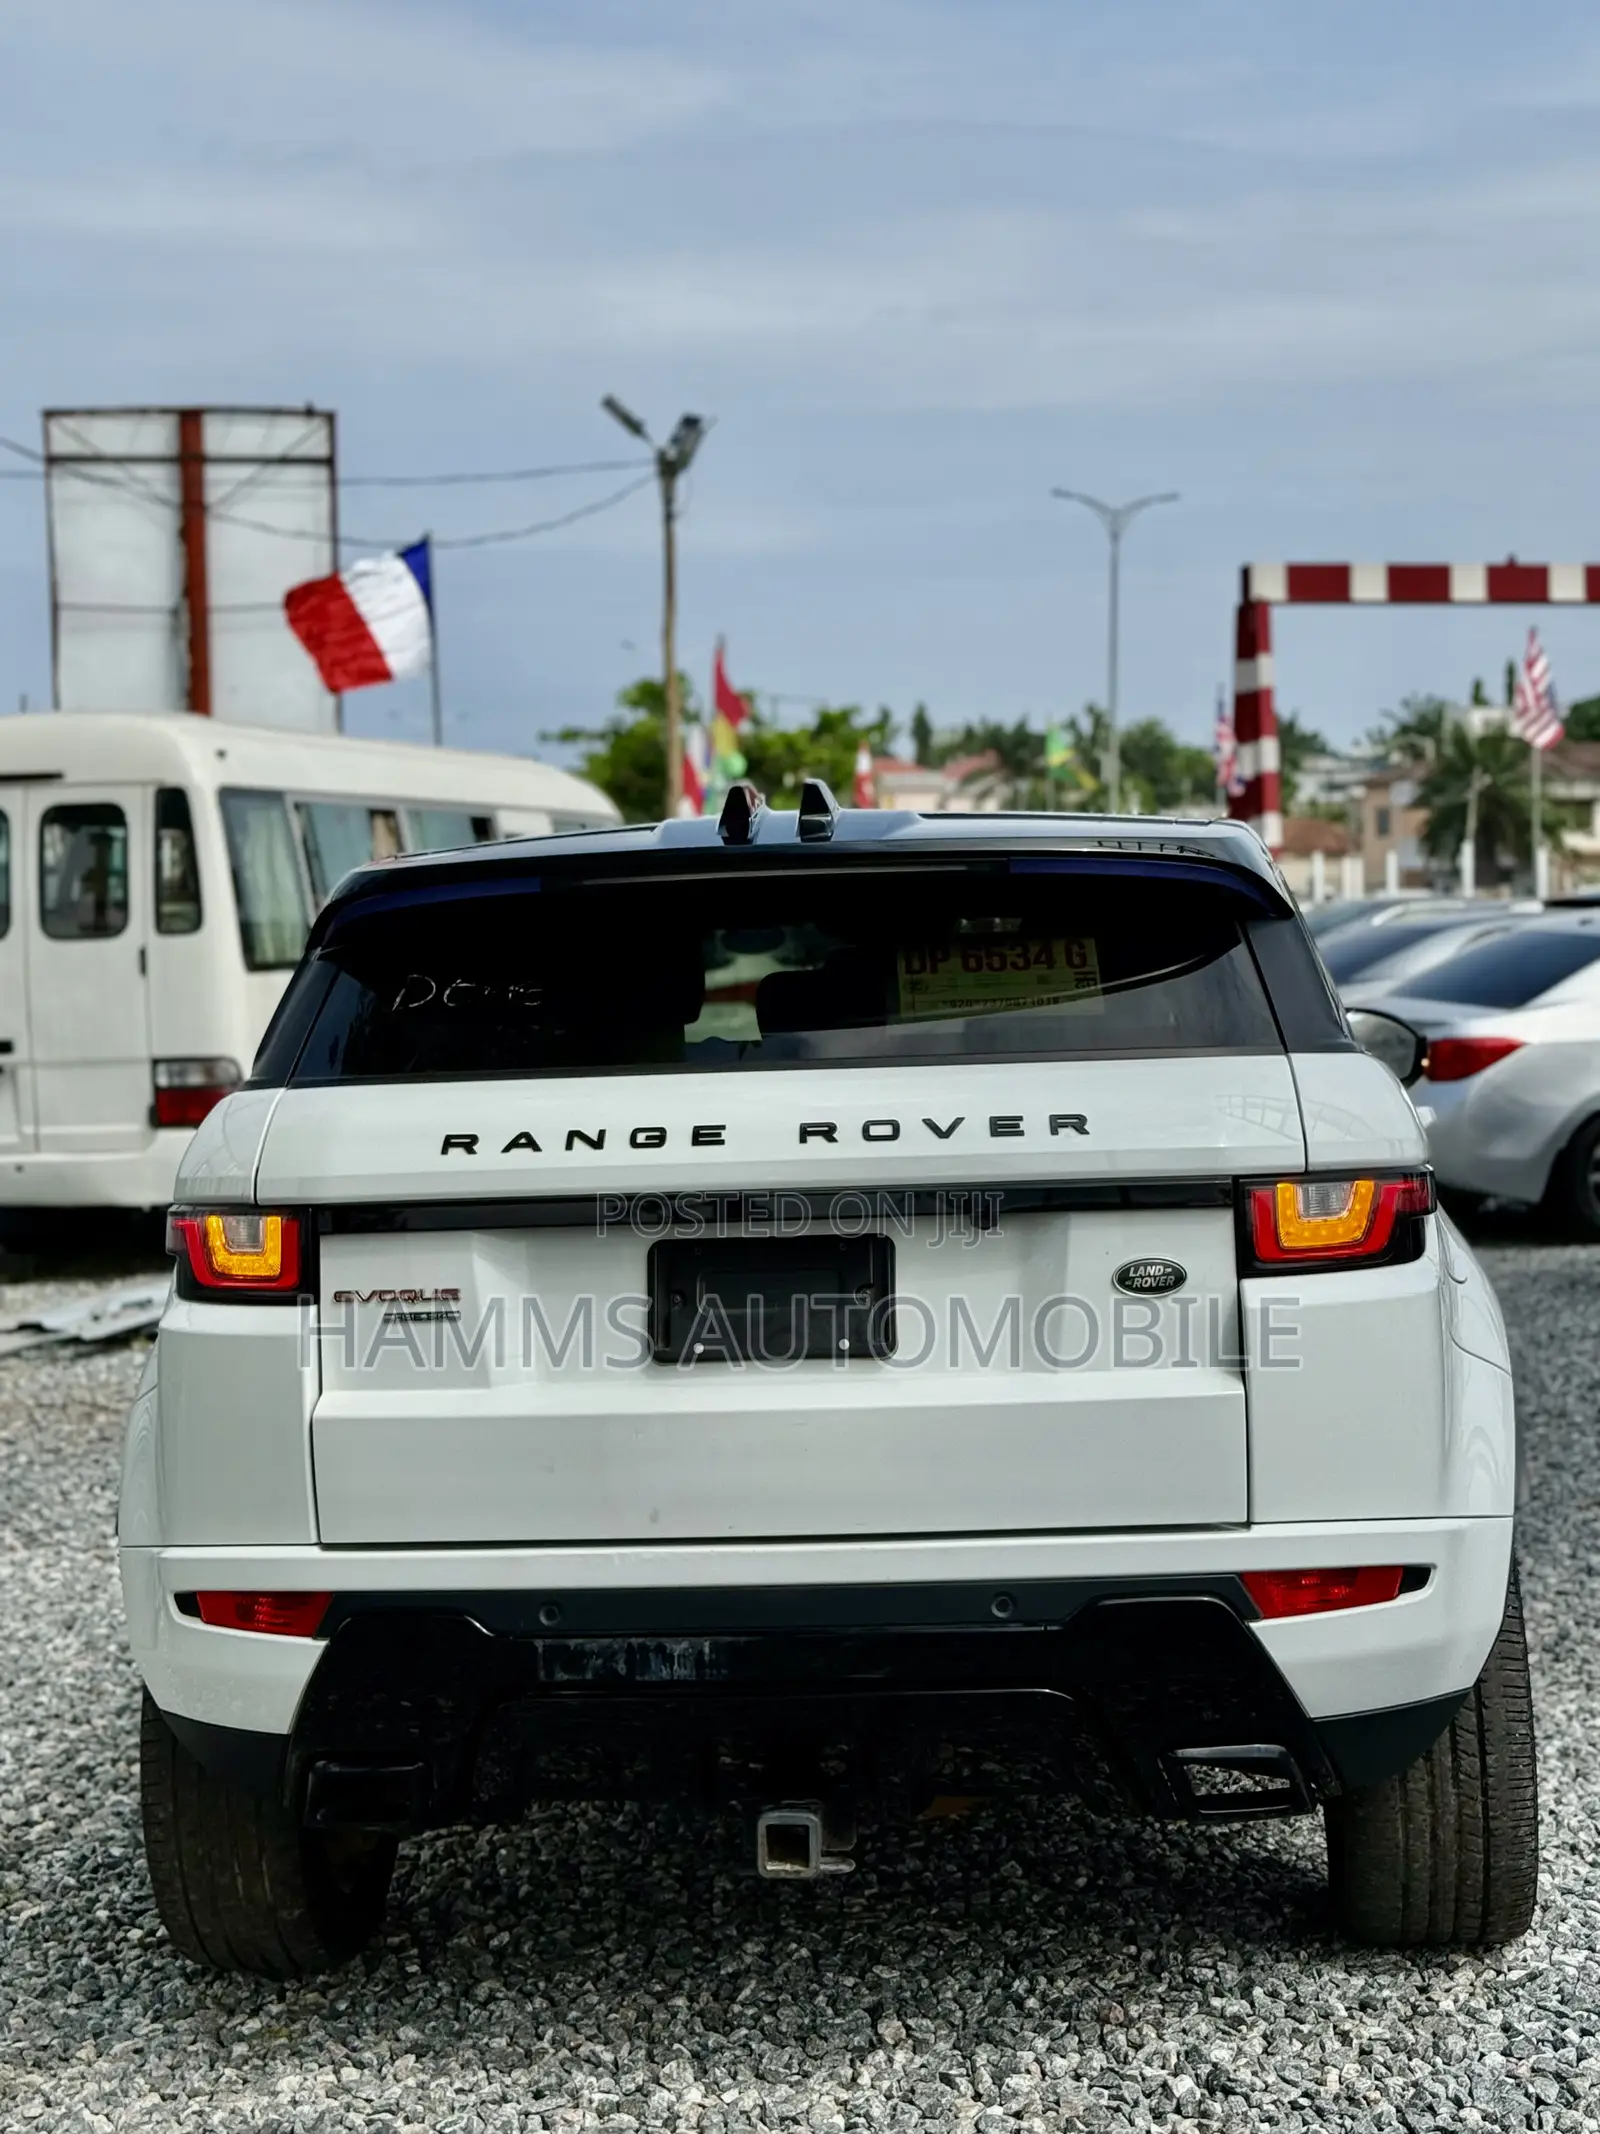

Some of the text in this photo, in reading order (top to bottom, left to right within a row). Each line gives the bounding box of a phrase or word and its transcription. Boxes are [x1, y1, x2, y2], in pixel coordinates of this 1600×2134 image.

[961, 940, 1057, 972] 6534
[1064, 938, 1088, 969] G
[440, 1114, 1090, 1155] RANGE ROVER
[1129, 1265, 1175, 1288] LAND ROVER
